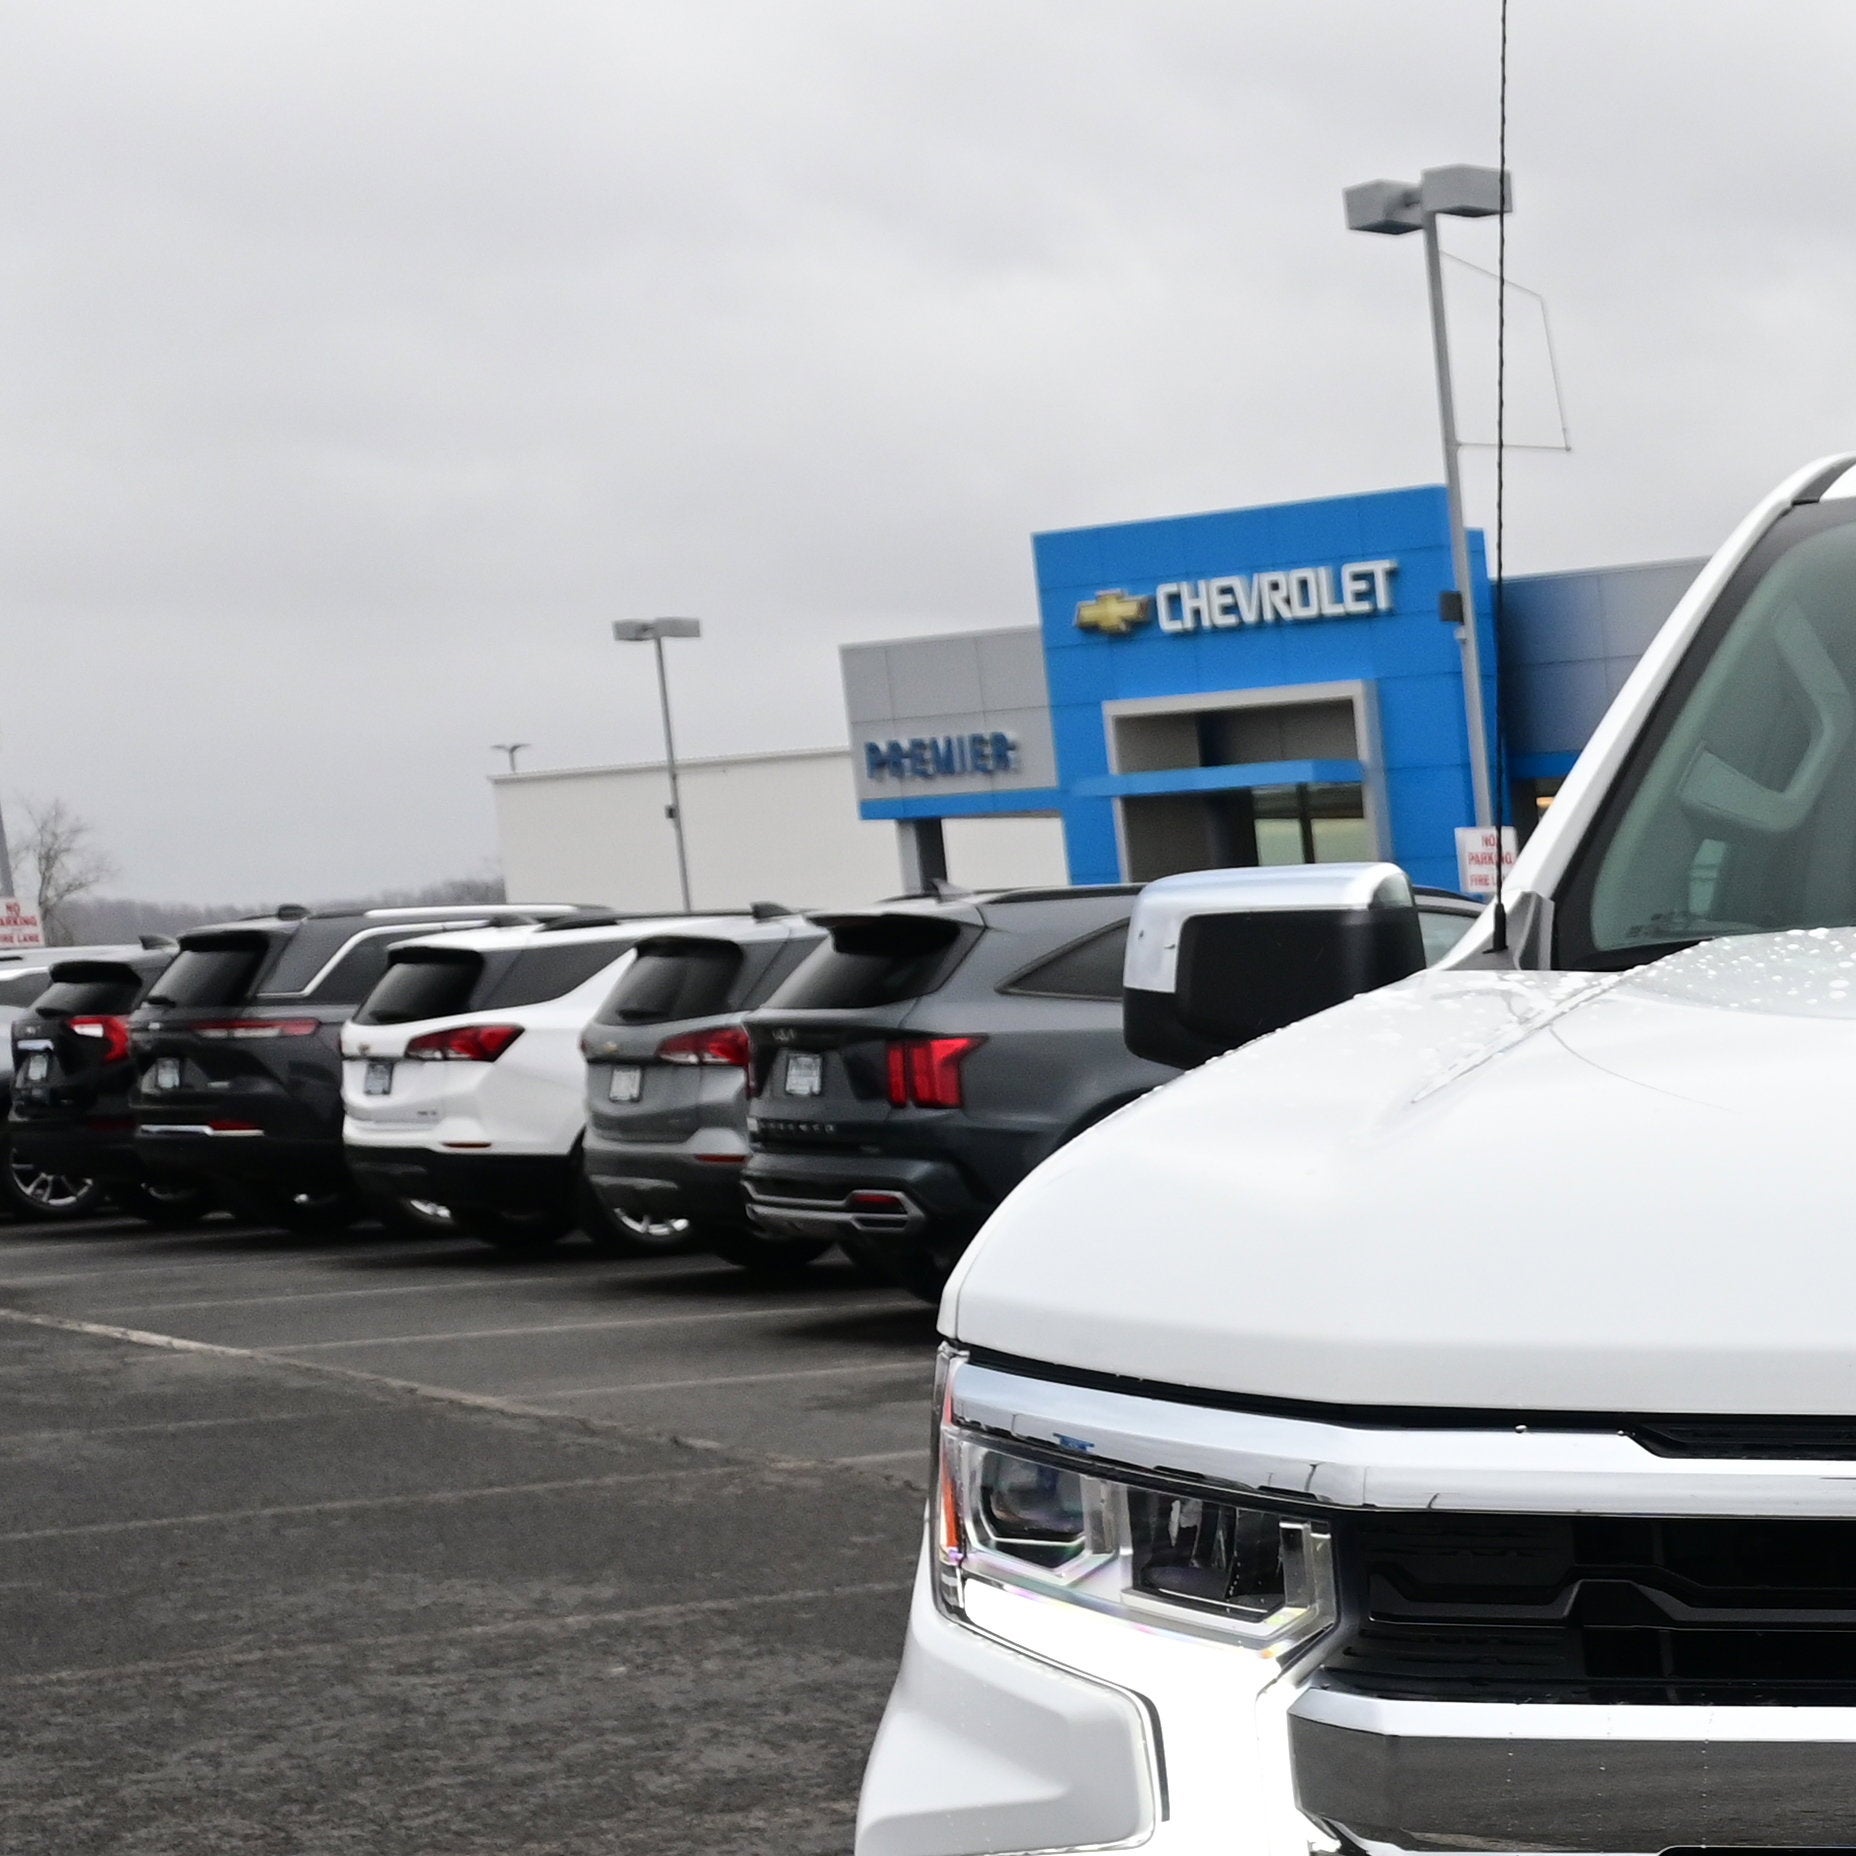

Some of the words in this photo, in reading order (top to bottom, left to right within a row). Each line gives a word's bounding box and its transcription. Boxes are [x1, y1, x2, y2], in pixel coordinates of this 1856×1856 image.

[1156, 559, 1398, 633] CHEVROLET
[864, 732, 1017, 781] PREMIER
[1481, 835, 1496, 847] NO
[1468, 853, 1513, 866] PARKNG
[0, 916, 38, 926] ARKING
